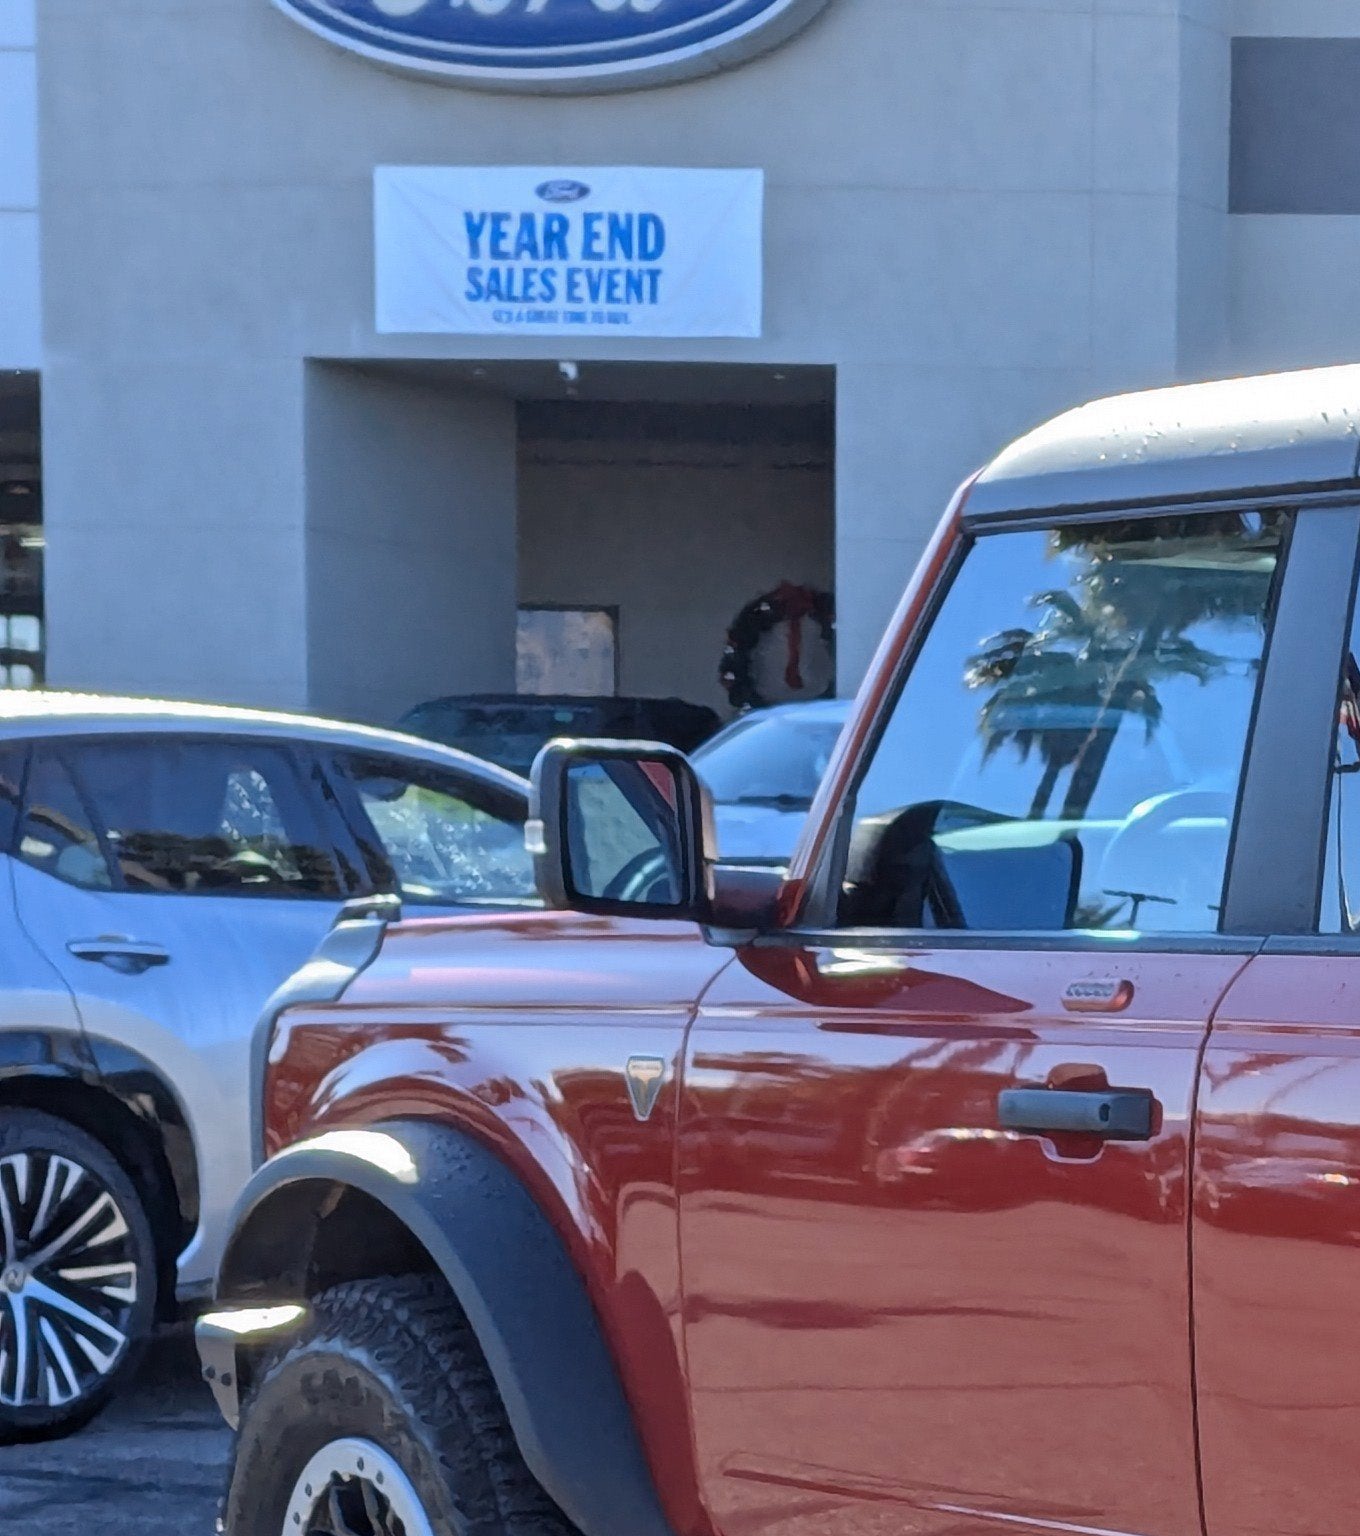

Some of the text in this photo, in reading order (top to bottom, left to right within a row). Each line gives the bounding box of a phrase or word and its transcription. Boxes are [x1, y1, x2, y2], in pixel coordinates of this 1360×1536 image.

[464, 211, 667, 262] YEAR END
[465, 267, 663, 305] SALES EVENT
